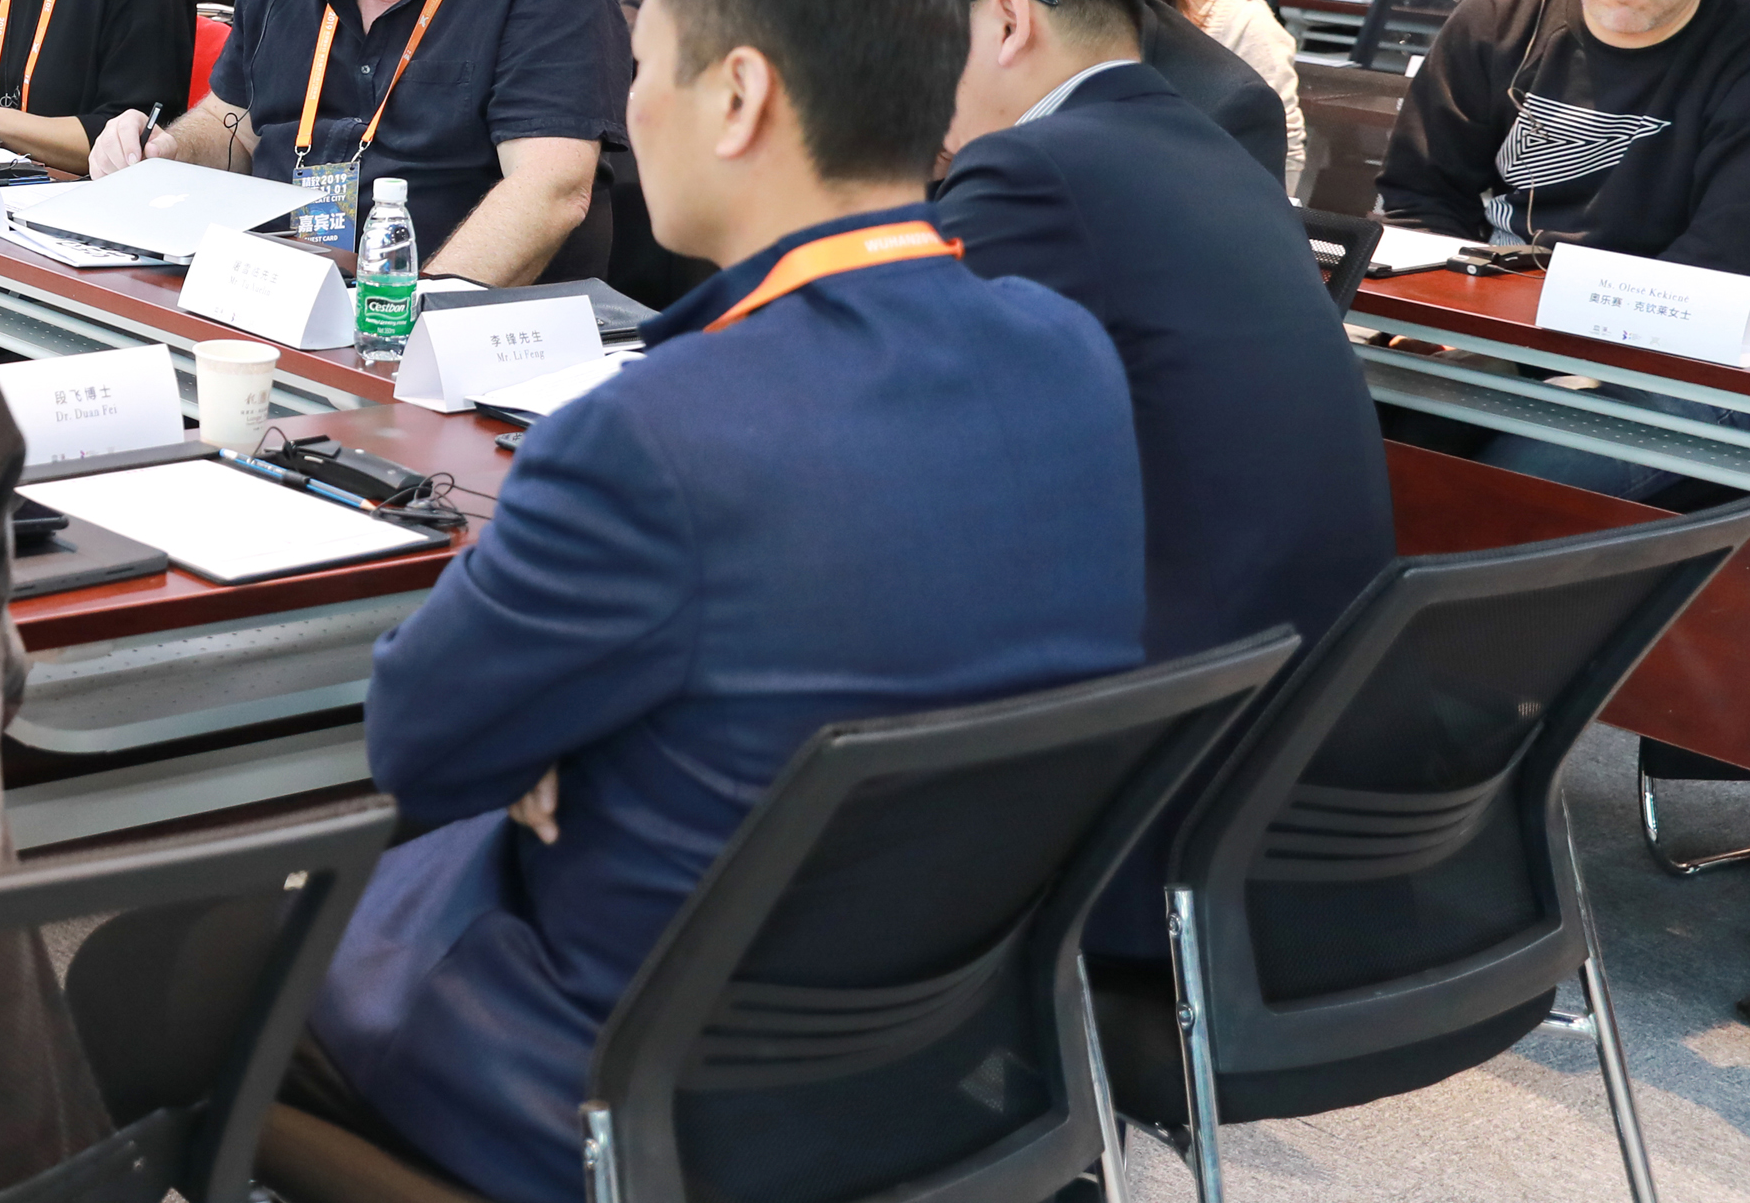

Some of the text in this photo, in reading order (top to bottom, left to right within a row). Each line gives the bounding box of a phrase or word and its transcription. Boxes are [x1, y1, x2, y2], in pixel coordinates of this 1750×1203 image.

[325, 11, 336, 30] 2019
[298, 212, 346, 233] 嘉宾证
[1599, 279, 1615, 290] Ms.
[496, 349, 546, 363] Mr. Li Feng
[54, 384, 112, 405] 段飞博士
[55, 404, 118, 423] Dr. Duan Fei
